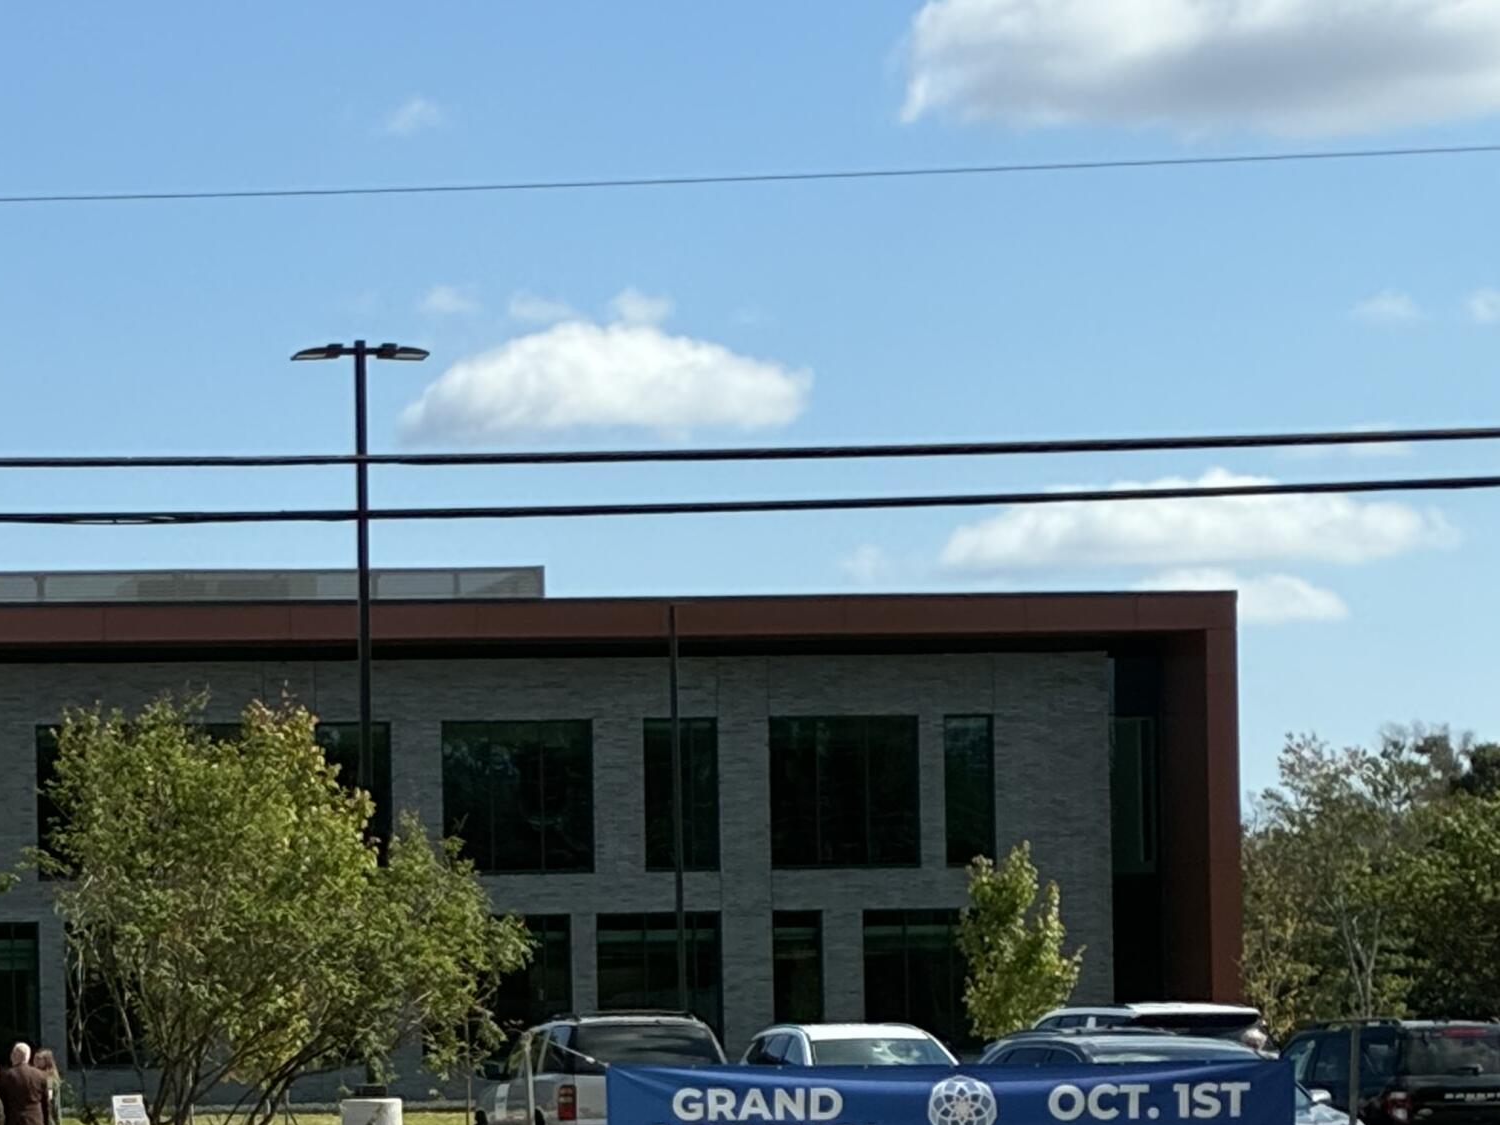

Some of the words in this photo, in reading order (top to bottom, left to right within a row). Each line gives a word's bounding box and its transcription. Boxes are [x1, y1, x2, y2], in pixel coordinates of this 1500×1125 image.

[672, 1087, 844, 1122] GRAND
[1047, 1083, 1159, 1121] OCT.
[1173, 1081, 1251, 1119] 1ST
